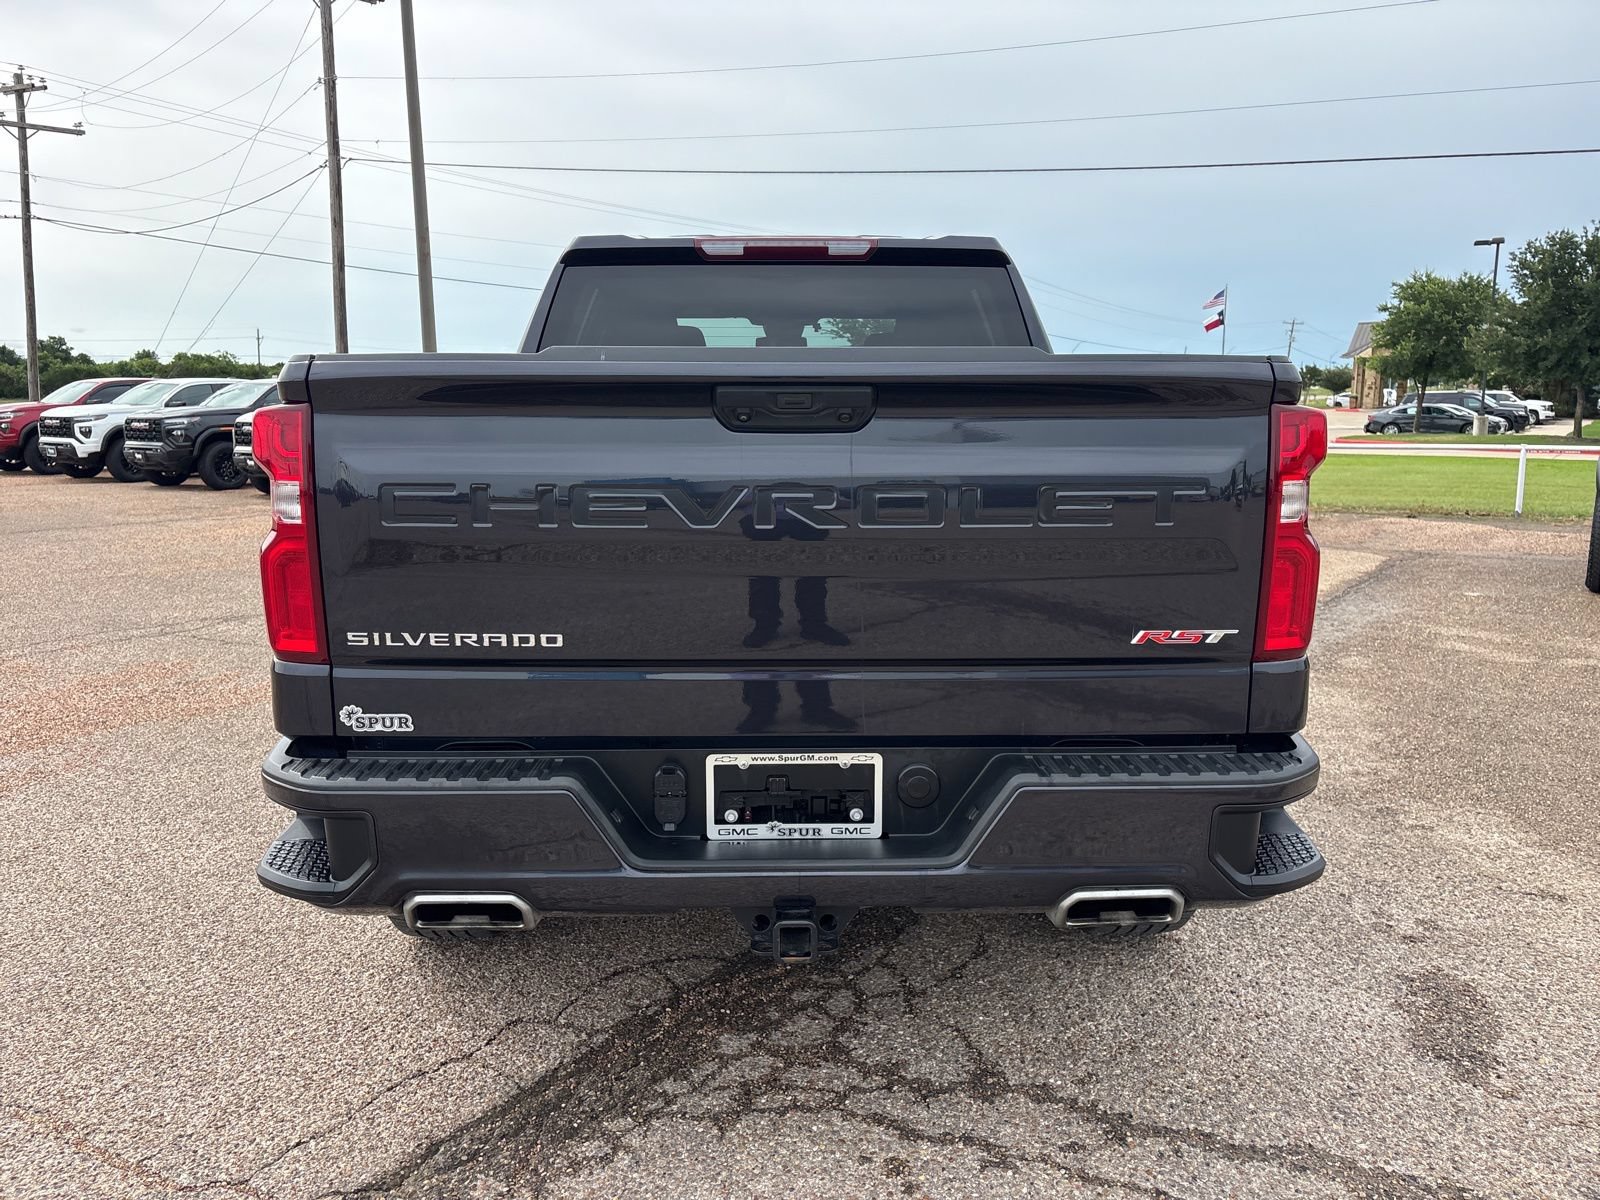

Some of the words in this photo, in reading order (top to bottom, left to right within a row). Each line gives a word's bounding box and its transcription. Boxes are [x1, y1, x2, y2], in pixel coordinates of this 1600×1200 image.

[378, 482, 1207, 529] CHEVROLET
[346, 632, 564, 647] SILVERADO
[1130, 629, 1239, 645] RST
[355, 716, 412, 730] SPUR
[751, 754, 838, 762] www.SpurGM.com
[718, 828, 758, 836] GMC
[777, 827, 822, 837] SPUR
[831, 827, 871, 835] GMC
